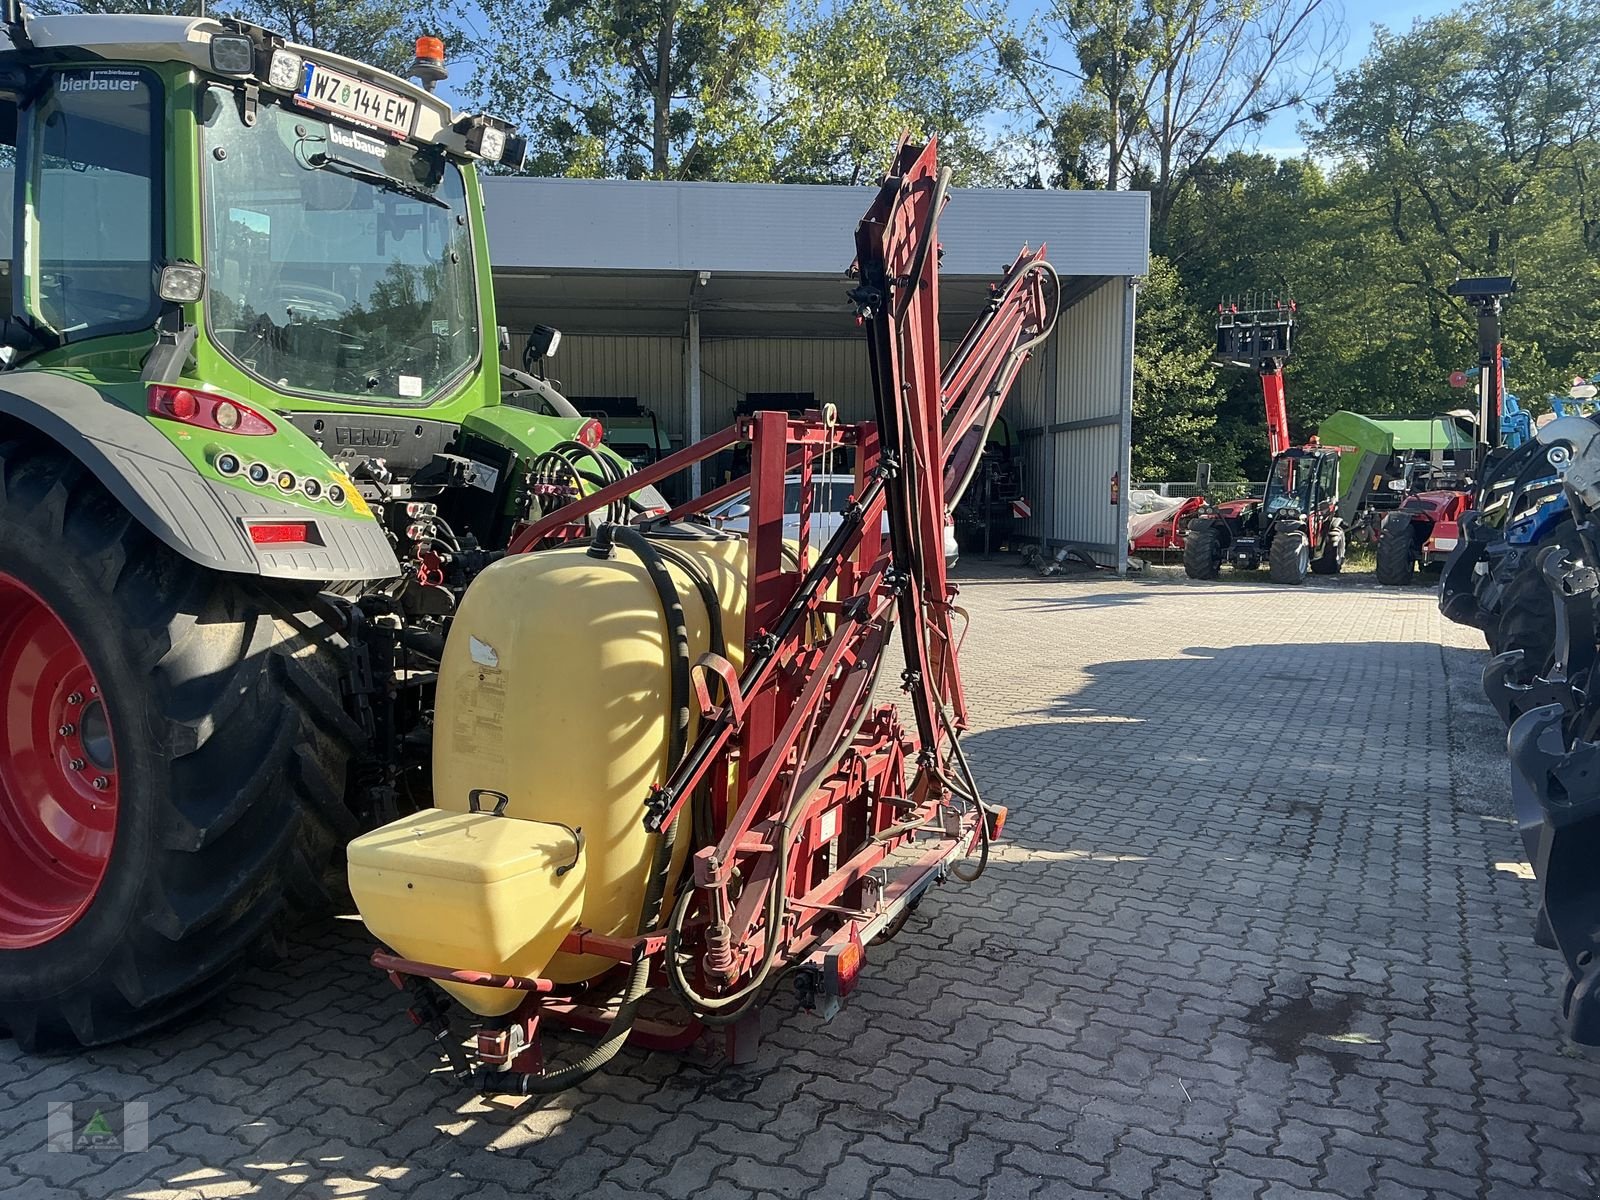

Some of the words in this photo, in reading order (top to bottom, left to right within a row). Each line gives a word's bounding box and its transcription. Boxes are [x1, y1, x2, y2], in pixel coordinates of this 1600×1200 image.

[60, 71, 139, 92] bierbauer
[314, 73, 341, 103] WZ
[353, 88, 381, 118] 144
[384, 98, 408, 127] EM
[329, 123, 387, 158] bierbauer
[335, 427, 405, 449] FENDT
